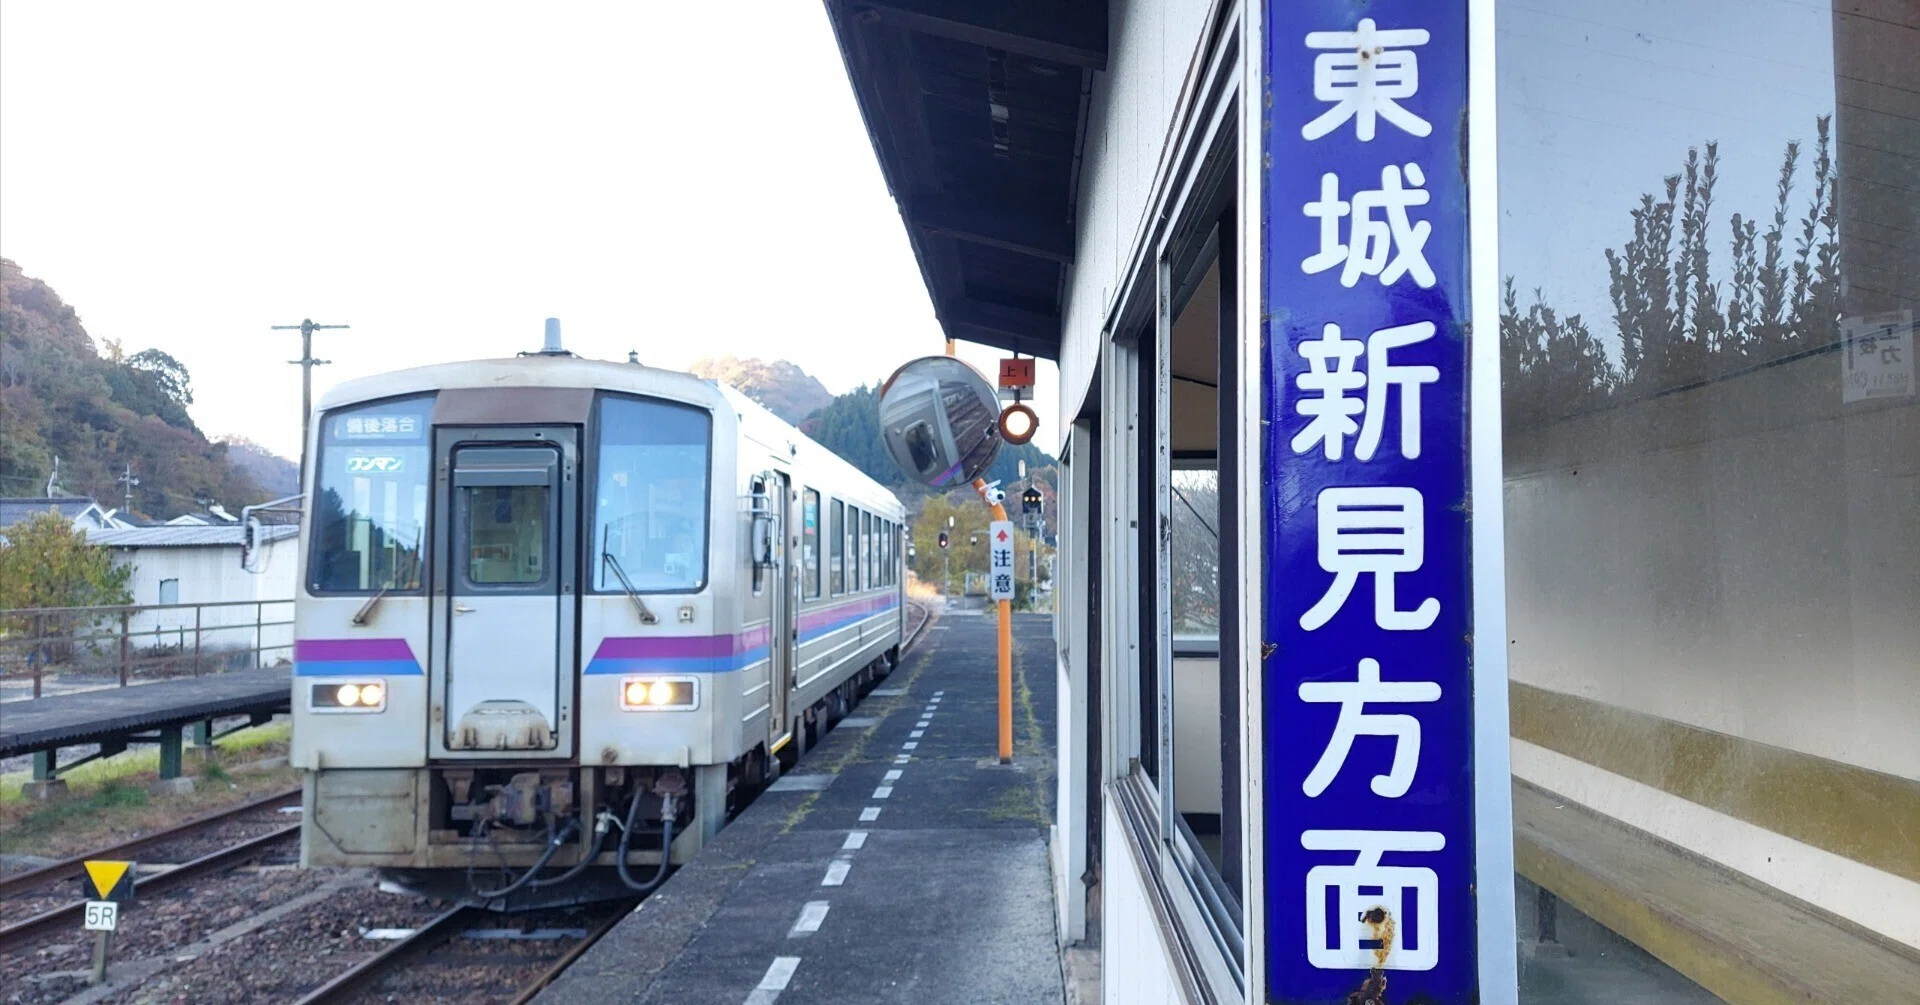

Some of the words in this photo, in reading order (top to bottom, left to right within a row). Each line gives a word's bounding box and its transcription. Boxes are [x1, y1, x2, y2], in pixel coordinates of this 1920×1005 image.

[348, 456, 402, 471] ワンマン
[1291, 18, 1446, 971] 東城新見方面
[994, 549, 1011, 593] 注意
[87, 906, 114, 926] 5R
